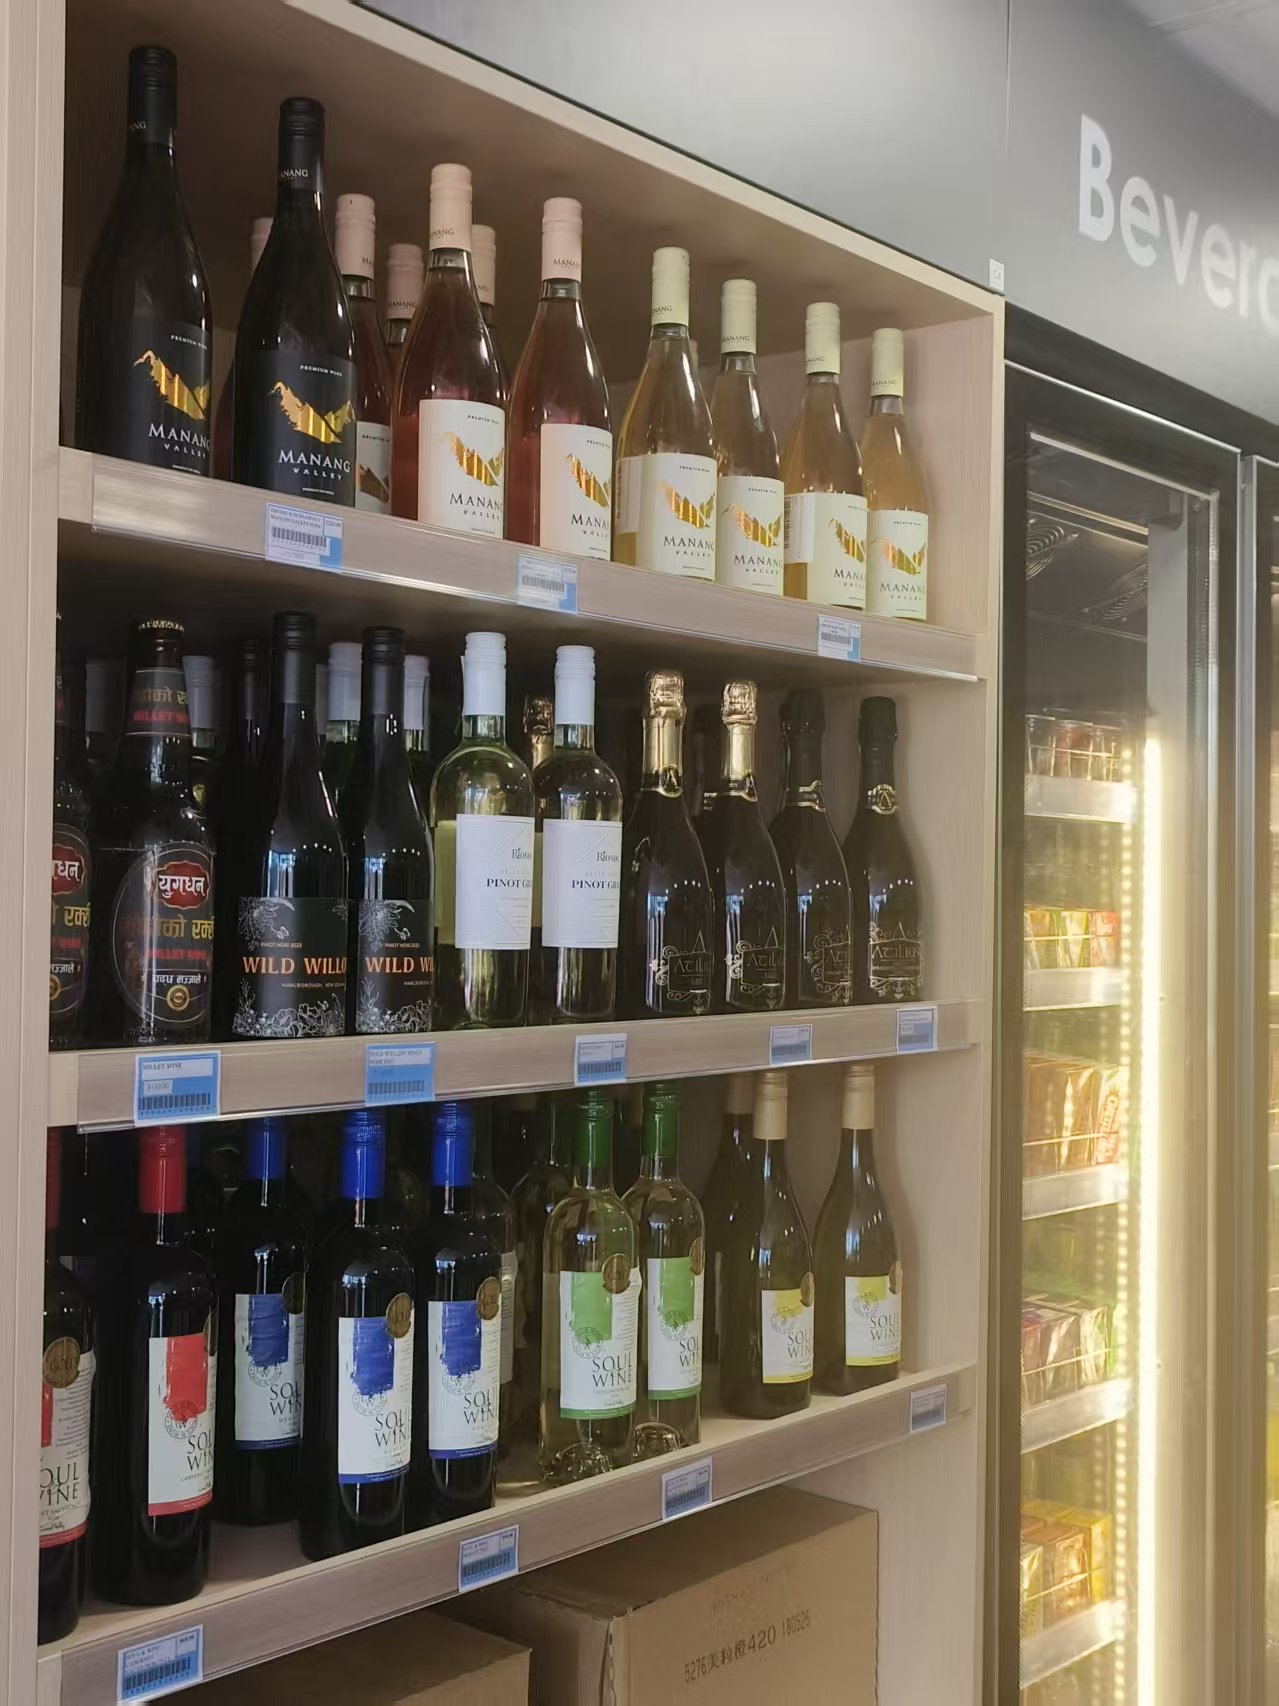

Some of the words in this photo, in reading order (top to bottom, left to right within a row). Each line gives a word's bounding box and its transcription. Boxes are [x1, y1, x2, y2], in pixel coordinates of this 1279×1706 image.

[300, 365, 329, 374] PREMIUM
[278, 448, 351, 473] MANANG
[293, 467, 343, 480] VALLEY
[158, 874, 206, 899] युगधन
[486, 878, 522, 888] PINOT
[571, 880, 606, 889] PINOT
[242, 956, 296, 974] WILD
[364, 956, 415, 973] WILD
[419, 956, 433, 973] WI
[870, 1312, 899, 1330] SOU
[870, 1328, 899, 1342] WIN
[592, 1368, 633, 1388] WINE
[463, 1405, 498, 1424] WIN
[374, 1427, 411, 1448] WIN
[40, 1462, 79, 1488] OUL
